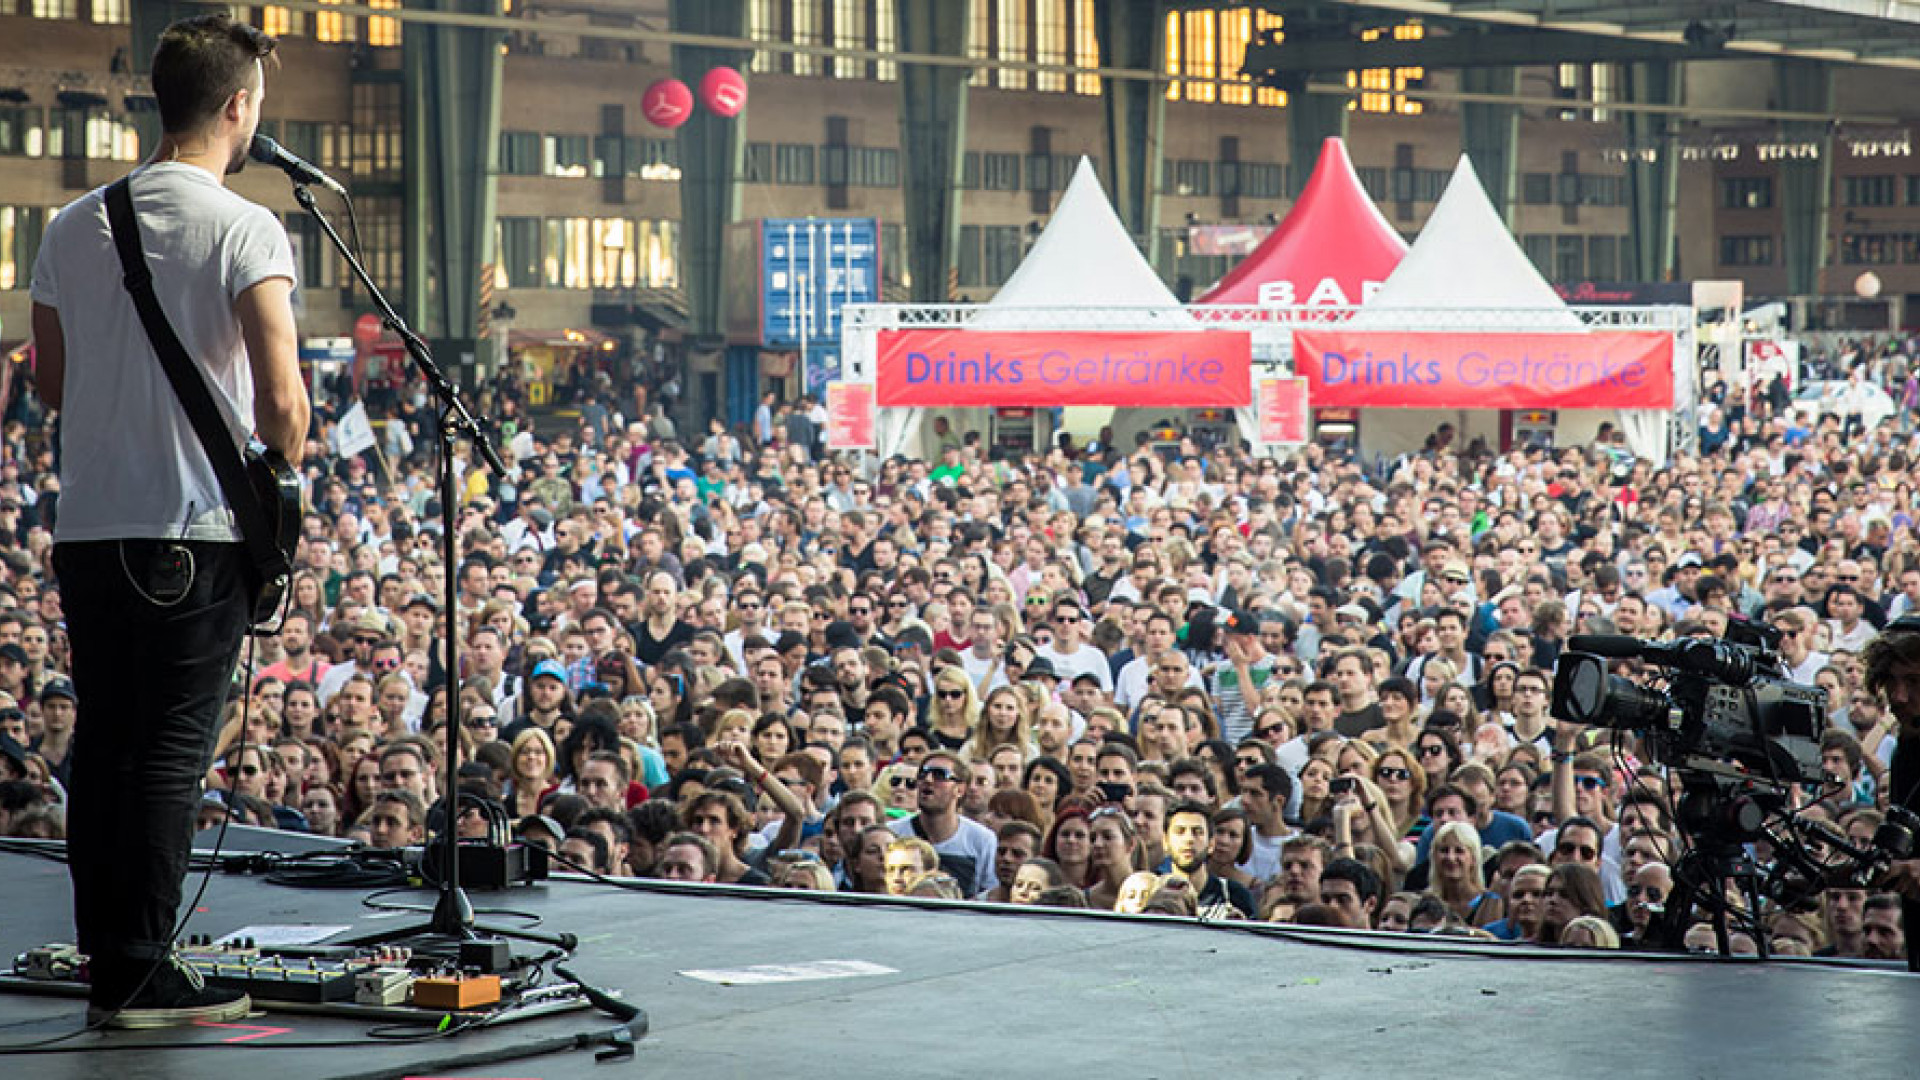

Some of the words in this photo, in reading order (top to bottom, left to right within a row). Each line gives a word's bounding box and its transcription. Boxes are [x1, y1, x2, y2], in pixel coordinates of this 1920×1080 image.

[906, 351, 1024, 384] Drinks
[1038, 350, 1225, 384] Getränke
[1322, 351, 1443, 385] Drinks
[1456, 350, 1647, 387] Getränke
